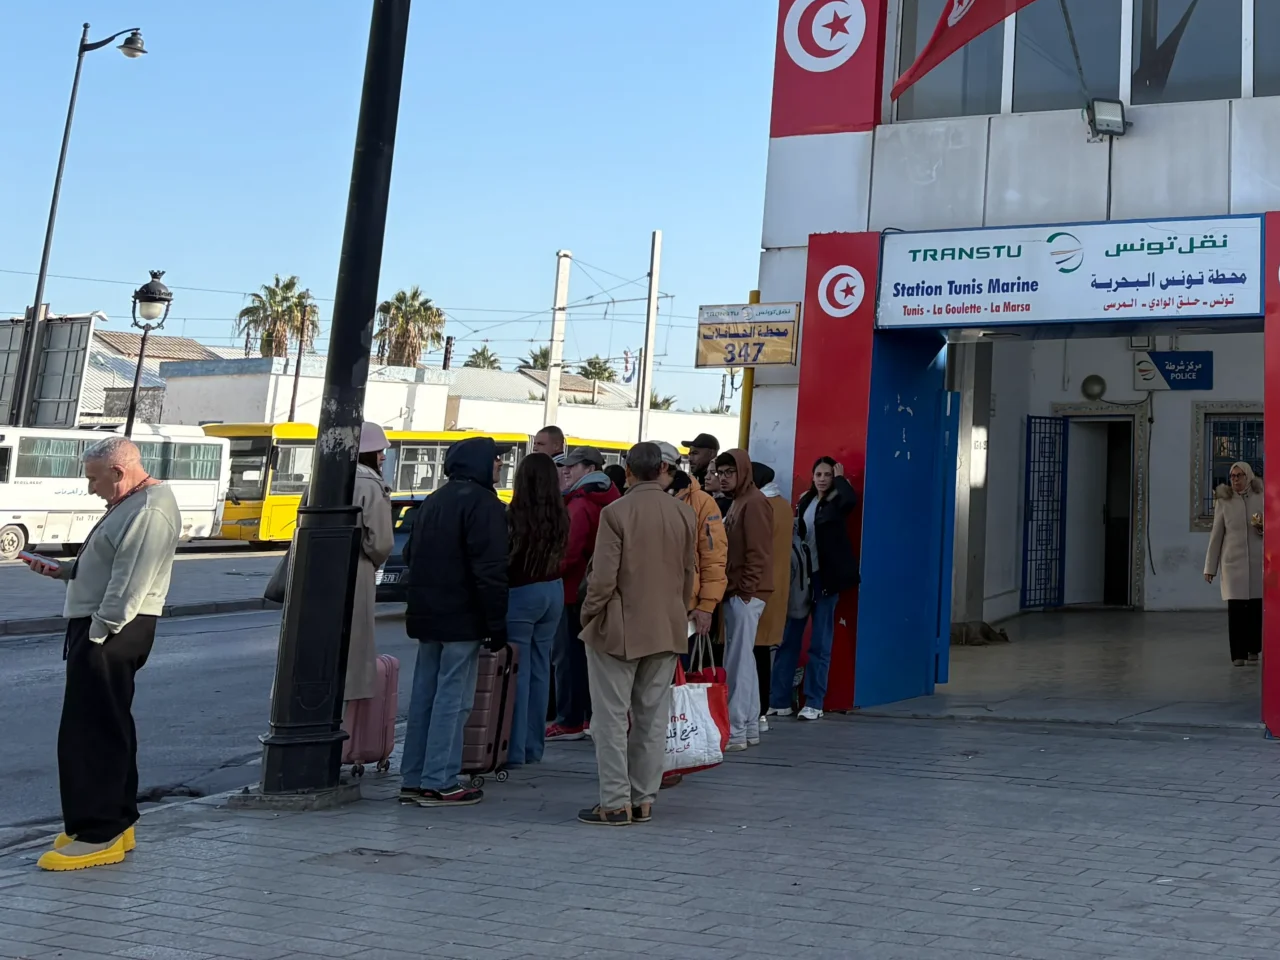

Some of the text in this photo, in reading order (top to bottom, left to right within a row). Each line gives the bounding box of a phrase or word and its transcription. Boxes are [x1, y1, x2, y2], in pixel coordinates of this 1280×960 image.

[908, 244, 1022, 262] TRANSTU
[1105, 234, 1228, 257] نقل تونس
[893, 276, 1039, 298] Station Tunis Marine
[1090, 269, 1247, 293] محطة تونس البحرية
[1103, 298, 1137, 311] المرسى
[1148, 297, 1175, 311] الوادي
[1176, 295, 1200, 310] حلق
[1209, 293, 1234, 308] تونس
[903, 304, 924, 316] Tunis
[933, 304, 943, 315] La
[945, 302, 982, 315] Goulette
[990, 302, 1001, 313] La
[1002, 301, 1031, 313] Marsa
[758, 324, 789, 337] محطة
[723, 342, 765, 363] 347
[1165, 360, 1202, 372] مركز شرطة
[1170, 372, 1196, 380] POLICE
